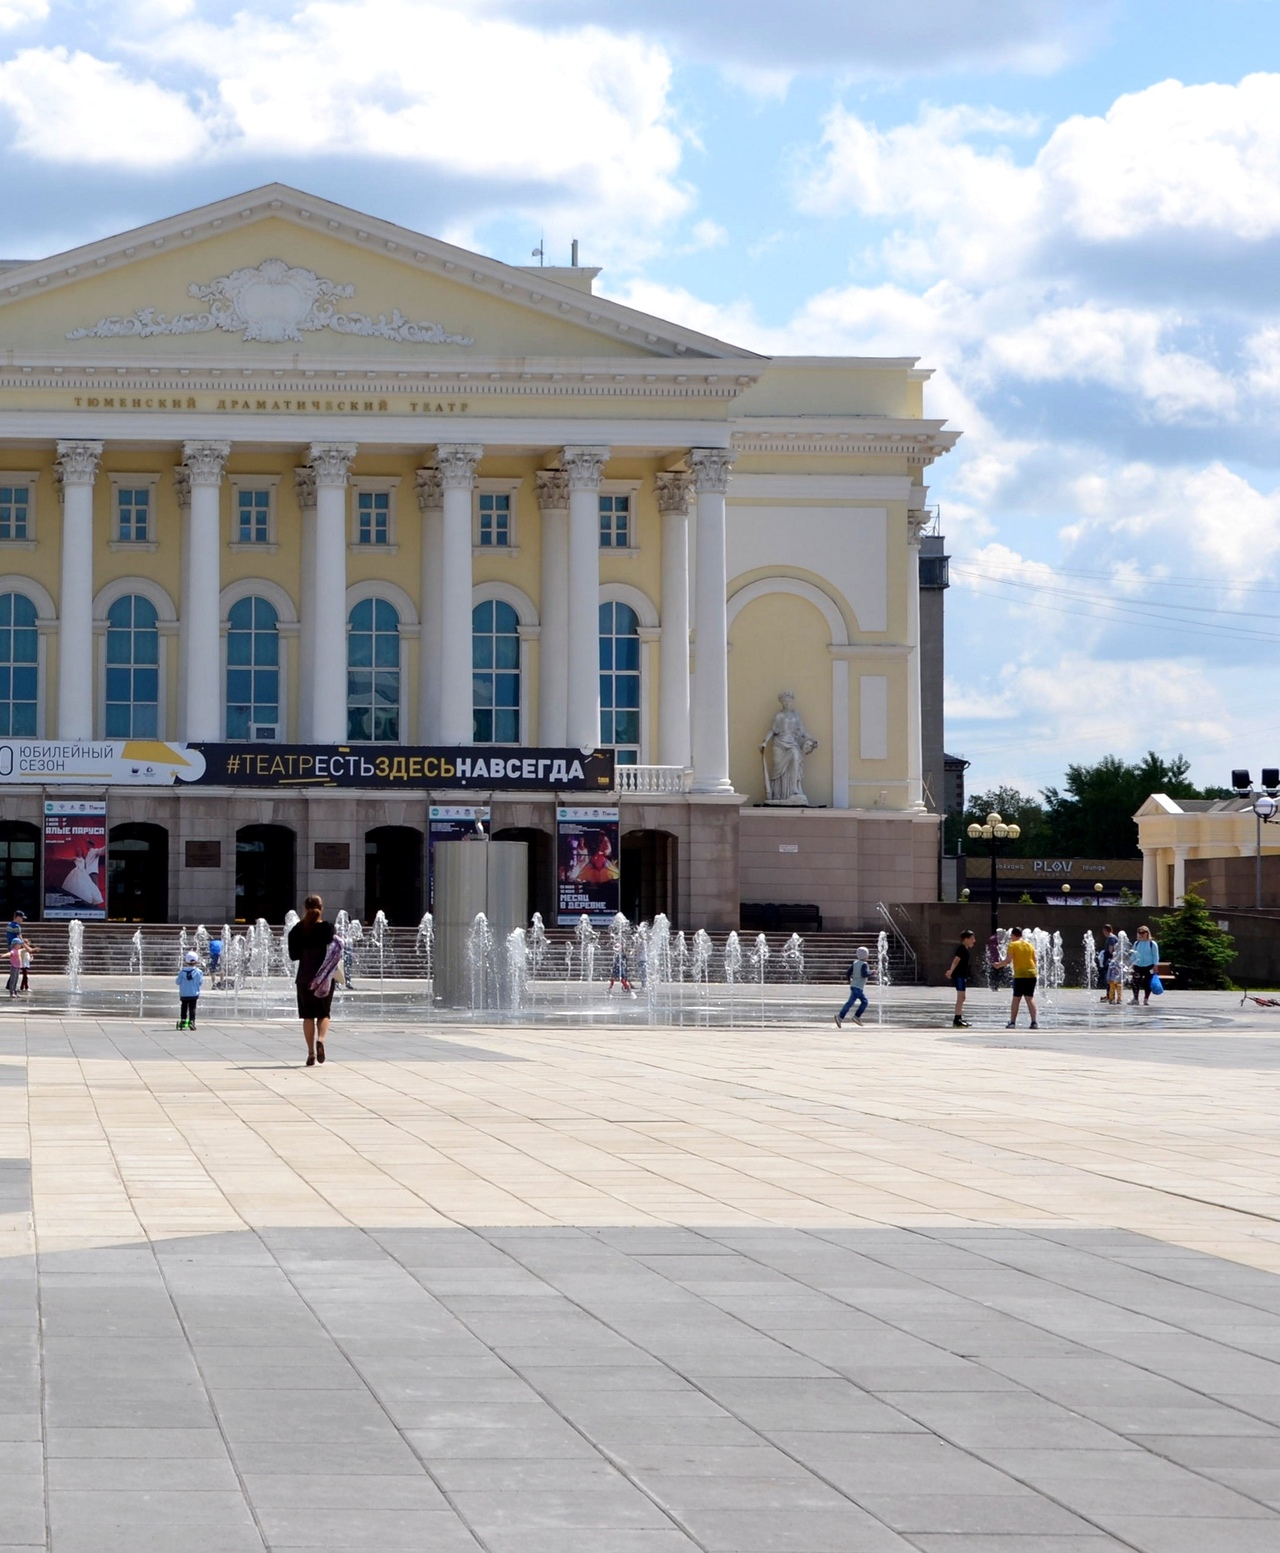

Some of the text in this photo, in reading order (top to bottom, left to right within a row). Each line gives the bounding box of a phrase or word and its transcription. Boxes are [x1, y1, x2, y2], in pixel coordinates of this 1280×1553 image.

[74, 397, 469, 412] ТЮМЕНСКИЙ ДРАМАТИЧЕСКИЙ ТЕАТР
[19, 745, 113, 758] ЮБИЛЕЙНЫЙ
[19, 760, 65, 771] СЕЗОН
[227, 754, 585, 782] #ТЕАТРЕСТЬЗДЕСЬНАВСЕГДА
[45, 827, 105, 835] АЛЫЕ ПАРУСА
[1033, 861, 1072, 872] PLOV
